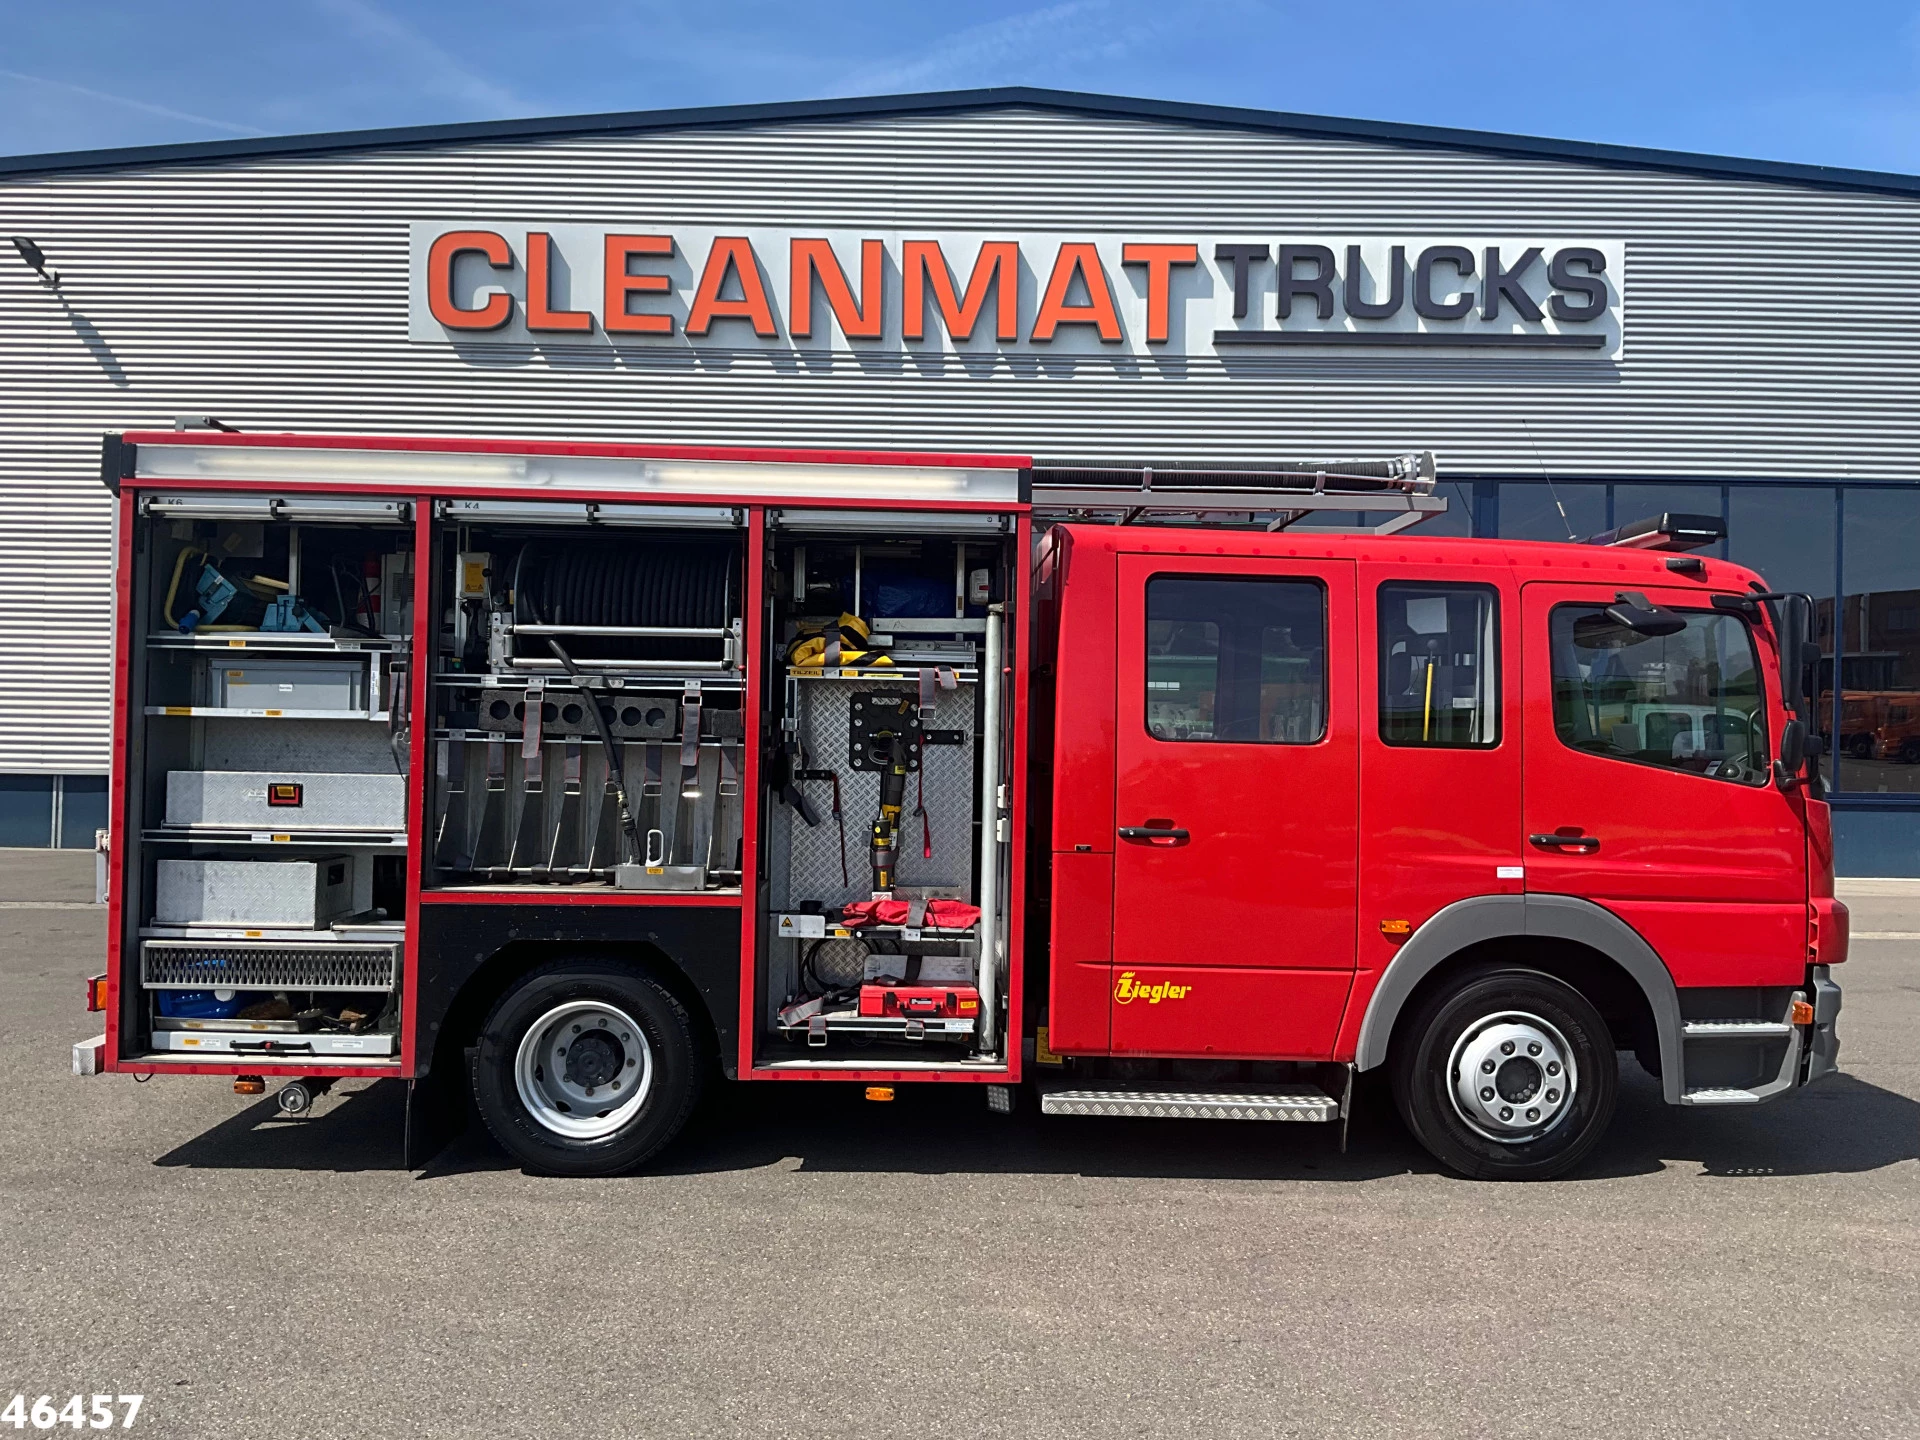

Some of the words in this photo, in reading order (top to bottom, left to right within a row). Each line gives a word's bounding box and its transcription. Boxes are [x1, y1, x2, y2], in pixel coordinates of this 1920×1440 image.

[427, 230, 1199, 343] CLEANMAT
[1214, 243, 1608, 322] TRUCKS
[1114, 974, 1192, 1004] Ziegler
